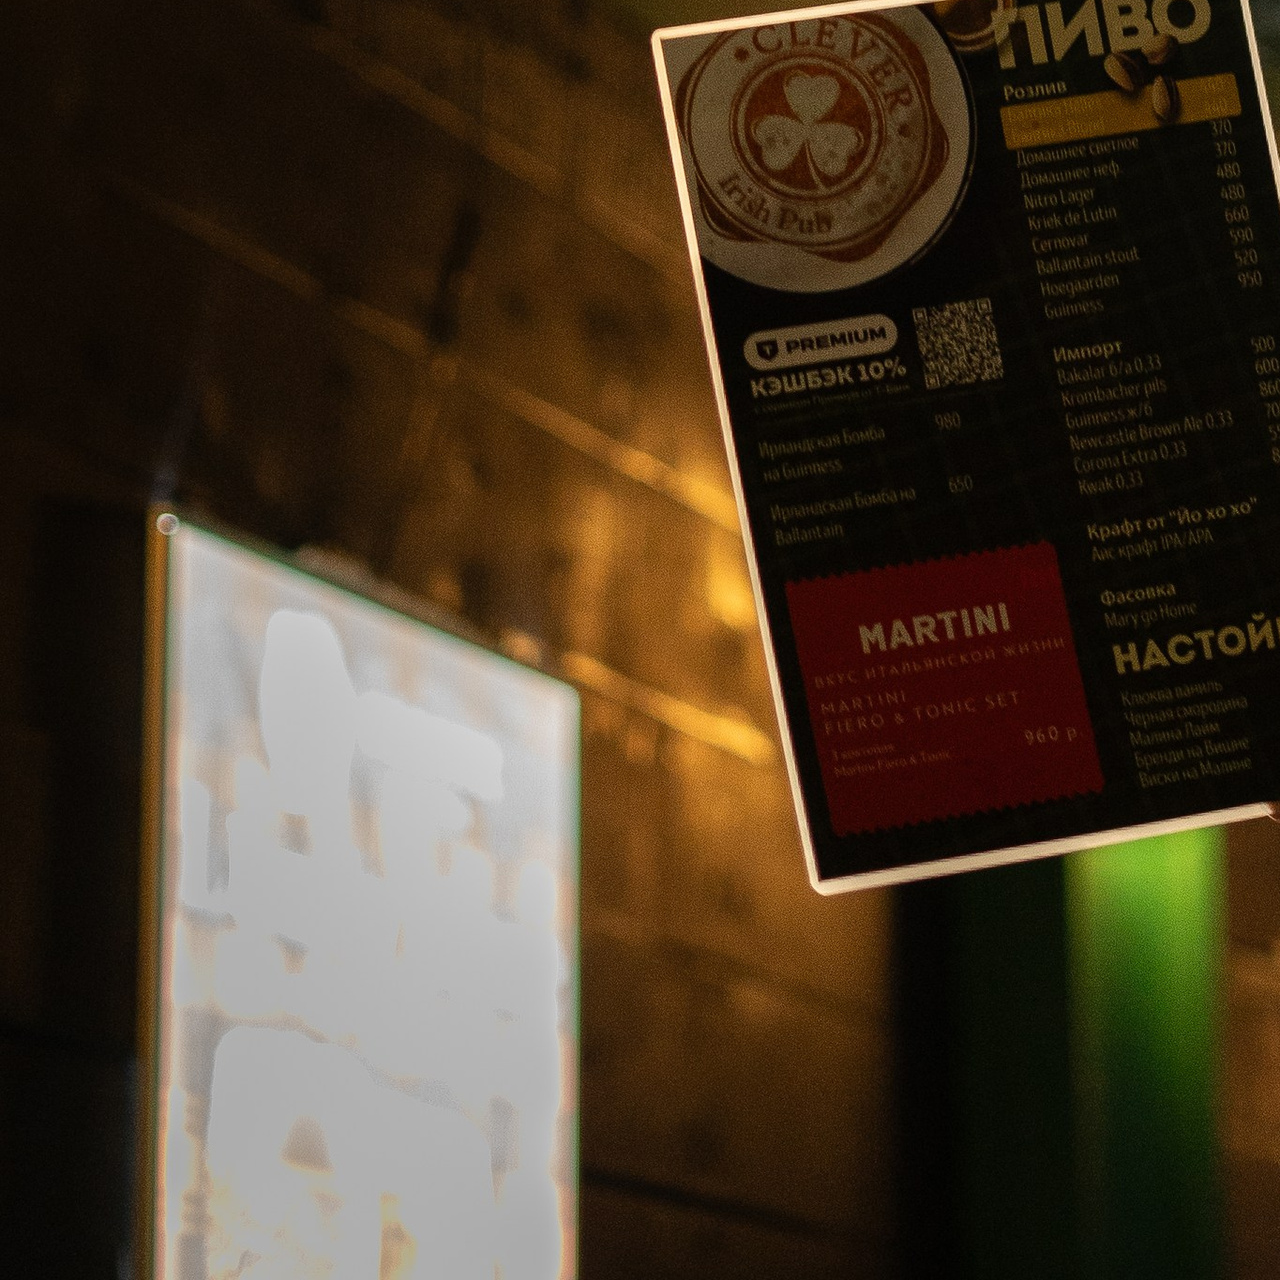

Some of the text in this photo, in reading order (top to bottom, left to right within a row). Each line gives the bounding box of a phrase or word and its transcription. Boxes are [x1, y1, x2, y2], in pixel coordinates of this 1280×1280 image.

[751, 19, 913, 111] CLEVER
[1002, 77, 1067, 101] Розлив
[717, 172, 832, 234] Irish Pub
[1022, 189, 1059, 210] Nitro
[1059, 185, 1096, 207] Lager
[1027, 212, 1062, 231] Kriek
[1062, 209, 1081, 226] de
[1082, 204, 1118, 224] Lutin
[1030, 230, 1089, 253] Cernovar
[1103, 245, 1140, 265] stout
[1040, 271, 1120, 298] Hoegaarden
[1043, 298, 1104, 319] Guinness
[784, 323, 888, 356] PREMIUM
[1052, 338, 1122, 364] Импорт
[1055, 361, 1106, 386] Bakalar
[1250, 334, 1276, 354] 500
[749, 356, 908, 399] КЭШБЭК 10%
[1060, 356, 1280, 408] Krombacher pils 600
[1137, 418, 1182, 440] Brown
[781, 457, 843, 481] Guinness
[1072, 450, 1121, 475] Corona
[1077, 474, 1114, 496] Kwak
[1086, 515, 1143, 543] Крафт
[1145, 515, 1166, 531] от
[1205, 505, 1228, 521] хо
[1099, 578, 1176, 607] Фасовка
[857, 599, 1011, 656] MARTINI
[813, 635, 1065, 690] ВКУС ИТАЛЬЯНСКОЙ ЖИЗНИ
[819, 688, 906, 717] MARTINI
[823, 711, 885, 737] FIERO
[913, 696, 976, 722] TONIC
[984, 689, 1020, 710] SET
[1023, 723, 1060, 746] 960
